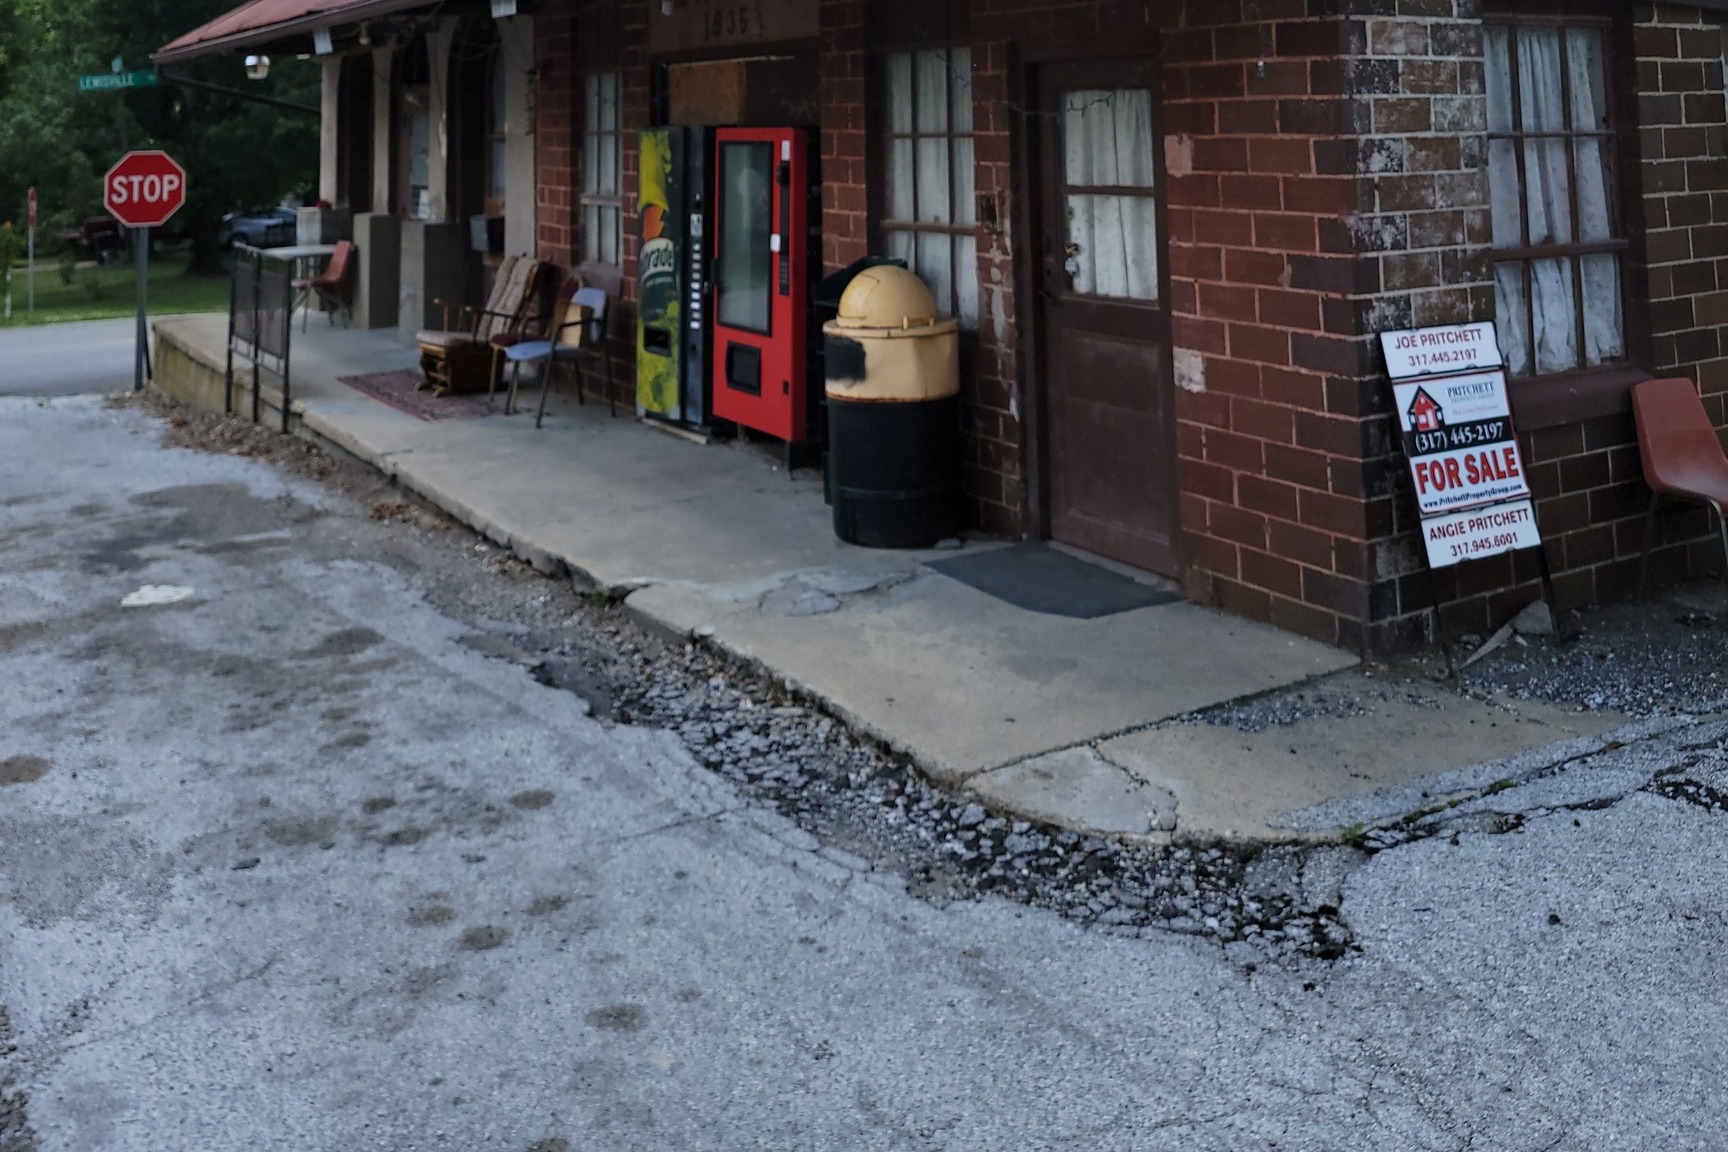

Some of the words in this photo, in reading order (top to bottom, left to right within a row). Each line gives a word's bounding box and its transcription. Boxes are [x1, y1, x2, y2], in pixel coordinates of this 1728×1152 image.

[79, 71, 135, 90] LEWISVILLE
[110, 174, 180, 204] STOP
[1395, 335, 1418, 350] JOE
[1420, 328, 1482, 346] PRITCHETT
[1408, 348, 1477, 367] 317.445.2197
[1446, 381, 1495, 398] PRITCHETT
[1415, 430, 1448, 454] (317)
[1450, 422, 1504, 445] 445-2197
[1415, 457, 1463, 495] FOR
[1464, 447, 1519, 485] SALE
[1430, 521, 1466, 541] ANGIE
[1468, 508, 1529, 533] PRITCHETT
[1451, 532, 1518, 557] 317.945.6001
